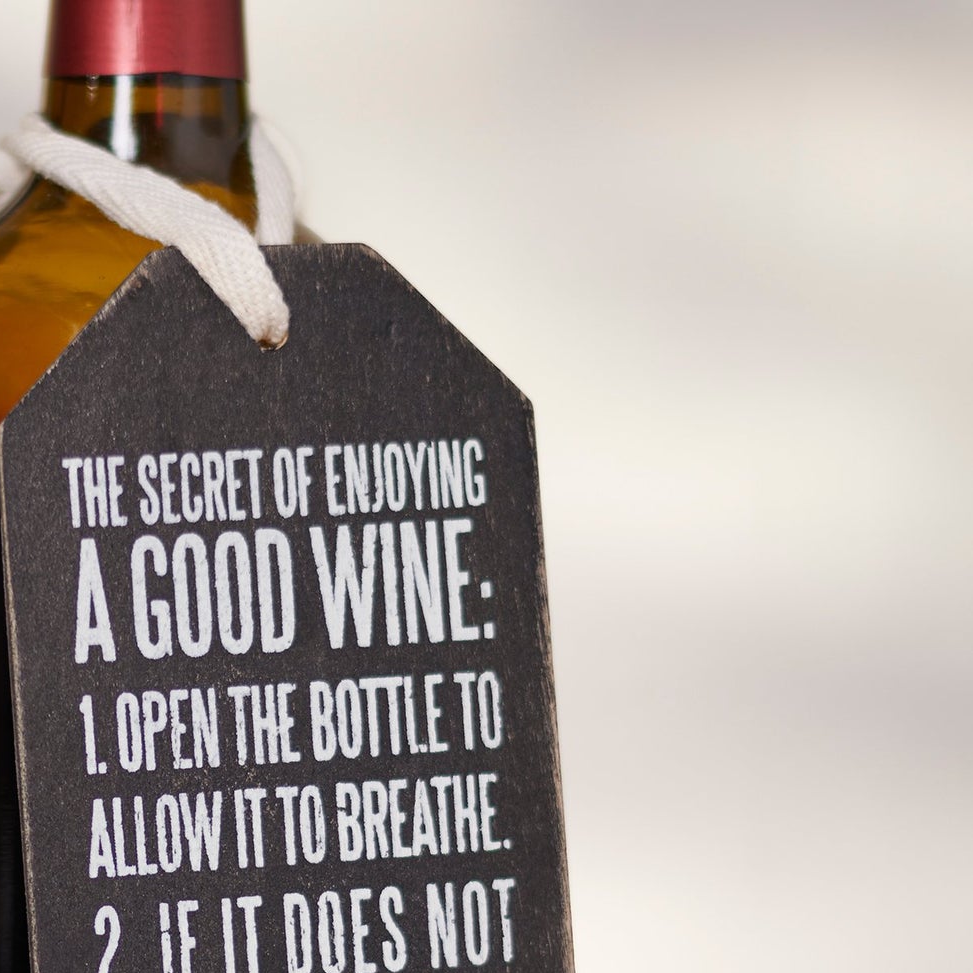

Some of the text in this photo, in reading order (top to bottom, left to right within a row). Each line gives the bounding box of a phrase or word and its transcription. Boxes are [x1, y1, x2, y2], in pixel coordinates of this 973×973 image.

[61, 439, 486, 528] THE SECRET OF ENJOYING
[74, 519, 495, 664] A GOOD WINE:
[79, 671, 501, 775] 1. OPEN THE BOTTLE TO
[89, 773, 511, 878] ALLOW IT TO BREATHE.
[425, 878, 515, 970] NOT
